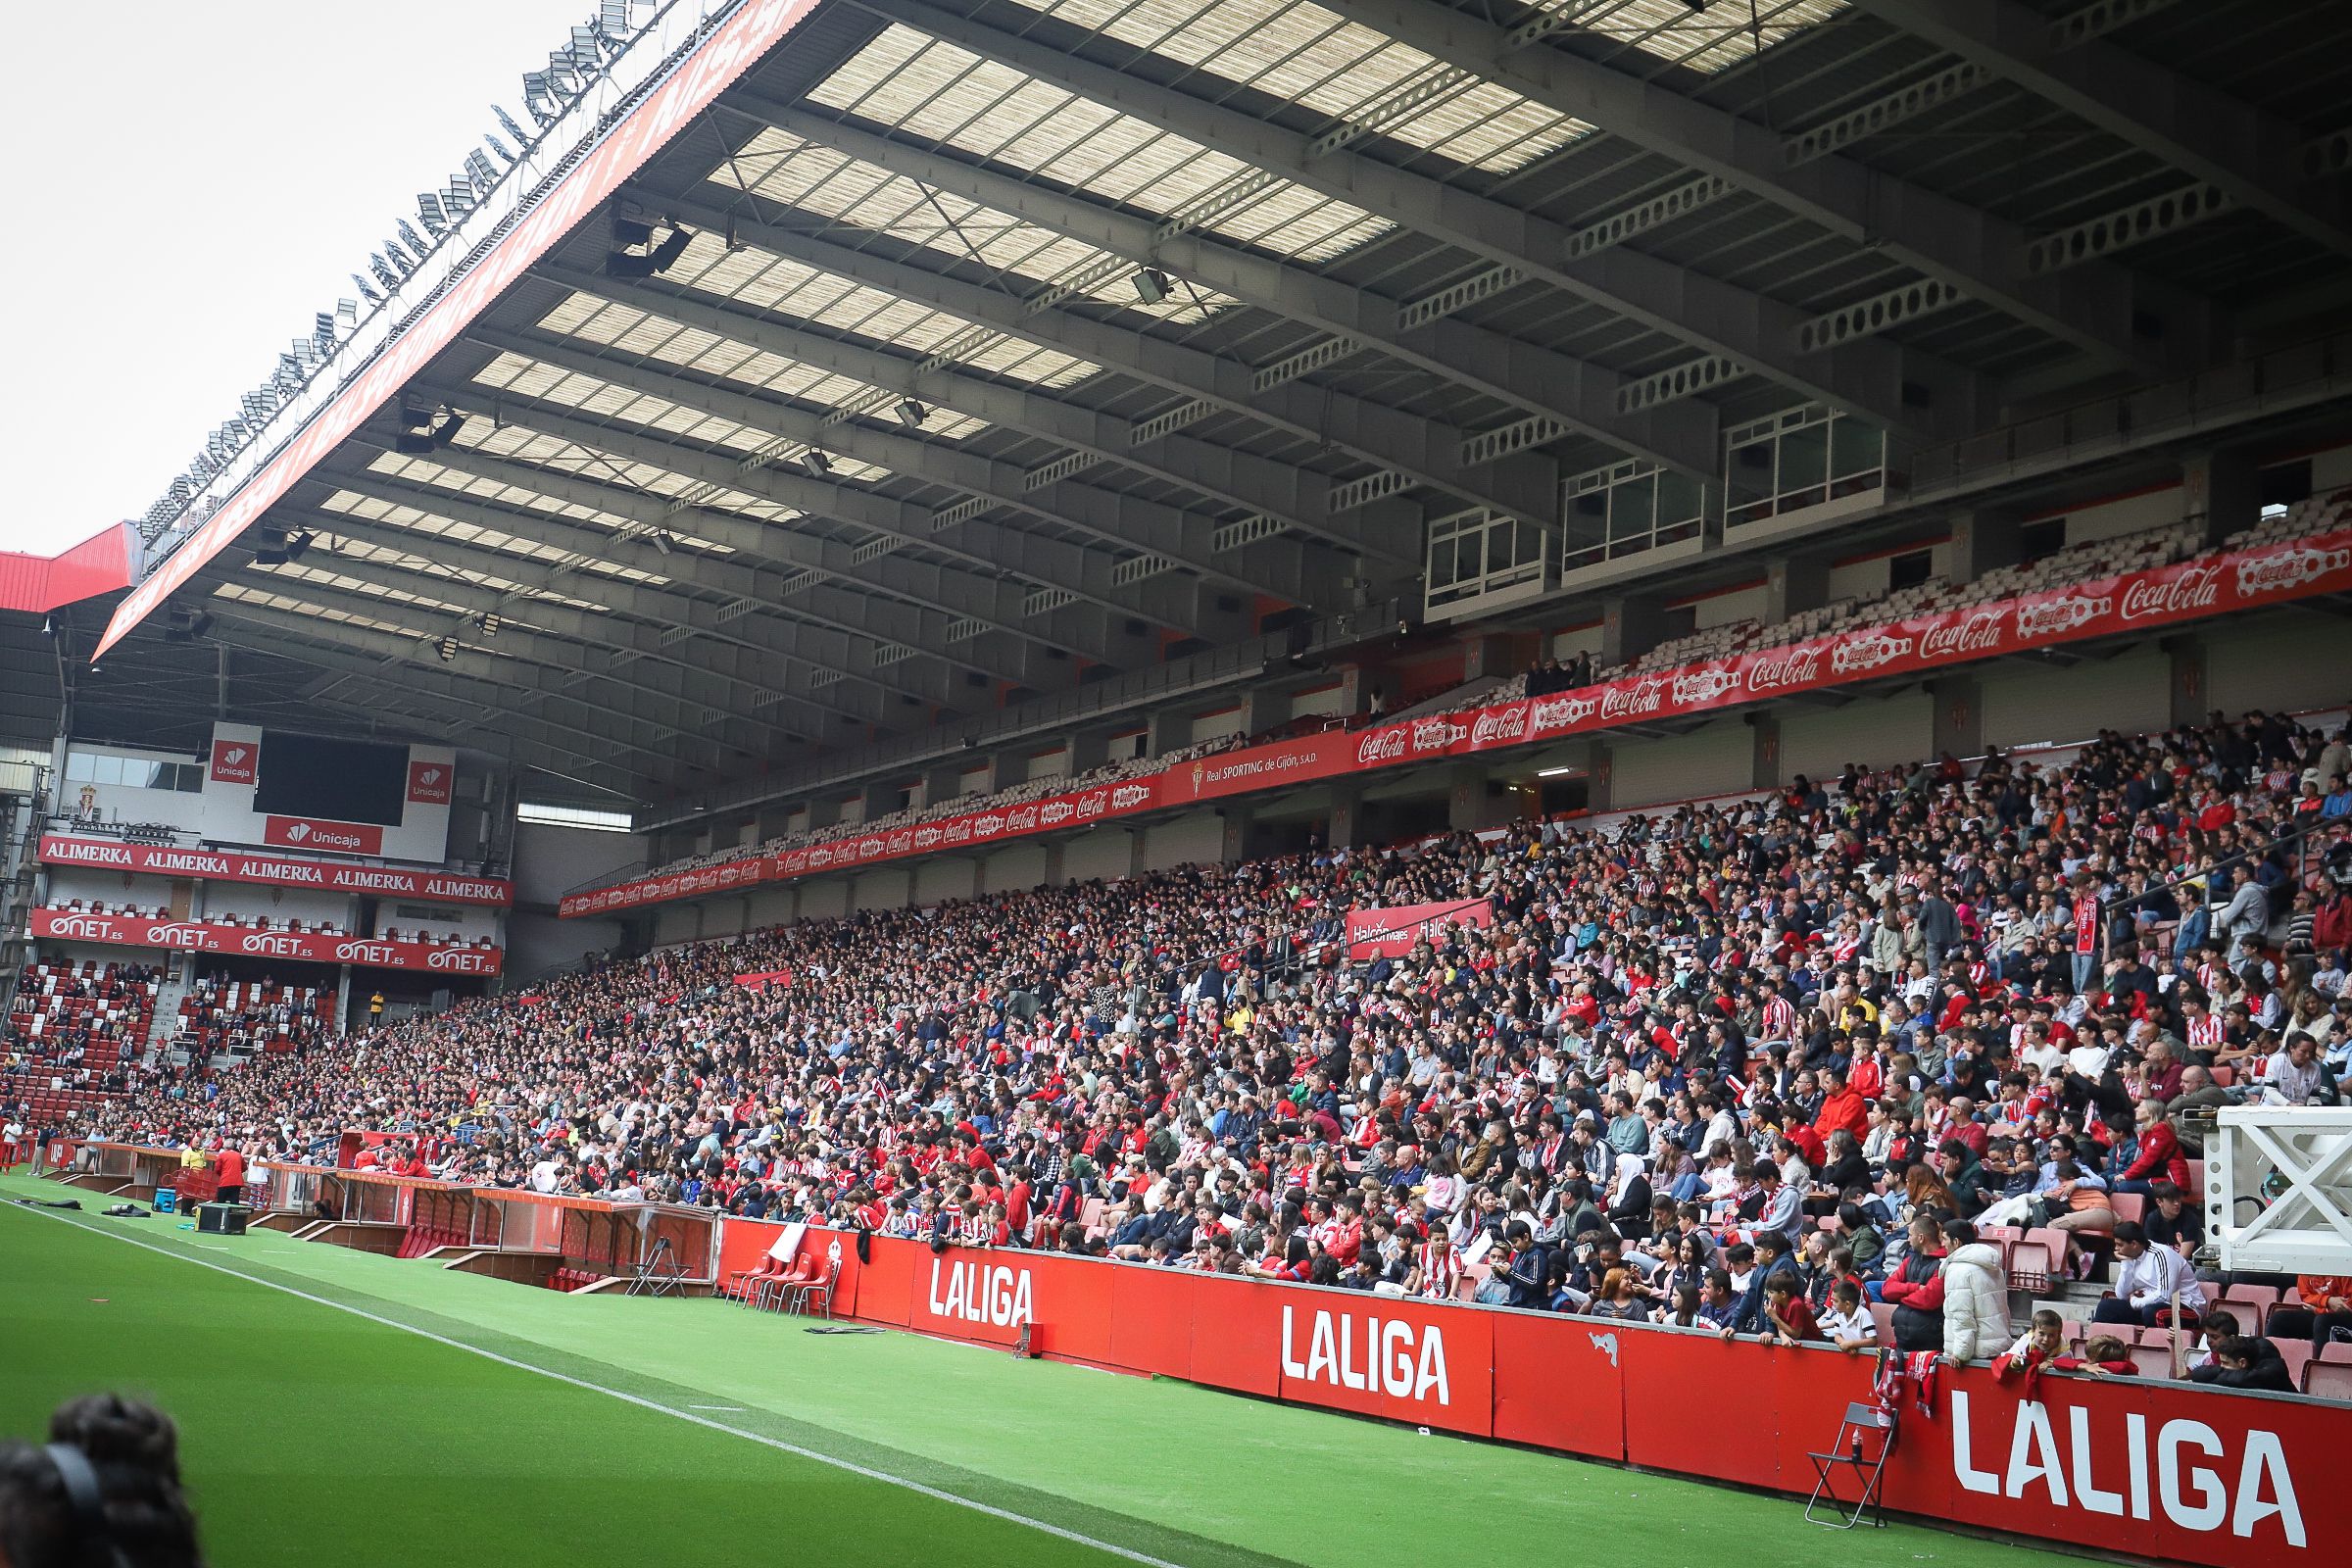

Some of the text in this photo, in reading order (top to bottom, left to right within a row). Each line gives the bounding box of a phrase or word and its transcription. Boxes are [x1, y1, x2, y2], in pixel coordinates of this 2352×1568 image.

[2121, 564, 2224, 620] Coca-Cola
[1919, 610, 2009, 660] Coca-Cola
[1748, 647, 1824, 692] Coca-Cola
[1601, 679, 1667, 719] Coca-Cola
[1472, 706, 1529, 744] Coca-Cola
[1358, 728, 1407, 763] Coca-Cola
[217, 766, 250, 778] Unicaja
[1206, 768, 1221, 782] Real
[1222, 760, 1263, 780] SPORTING
[1264, 759, 1275, 771] de
[1299, 753, 1317, 764] S.A.D.
[413, 787, 445, 799] Unicaja
[1077, 790, 1108, 819] Coca-Cola
[1006, 806, 1039, 832] Coca-Cola
[46, 843, 132, 865] ALIMERKA
[313, 831, 361, 849] Unicaja
[144, 852, 229, 873] ALIMERKA
[239, 860, 323, 882] ALIMERKA
[332, 870, 415, 892] ALIMERKA
[424, 879, 506, 901] ALIMERKA
[929, 1257, 1033, 1328] LALIGA
[1281, 1304, 1450, 1406] LALIGA
[1951, 1390, 2306, 1548] LALIGA
